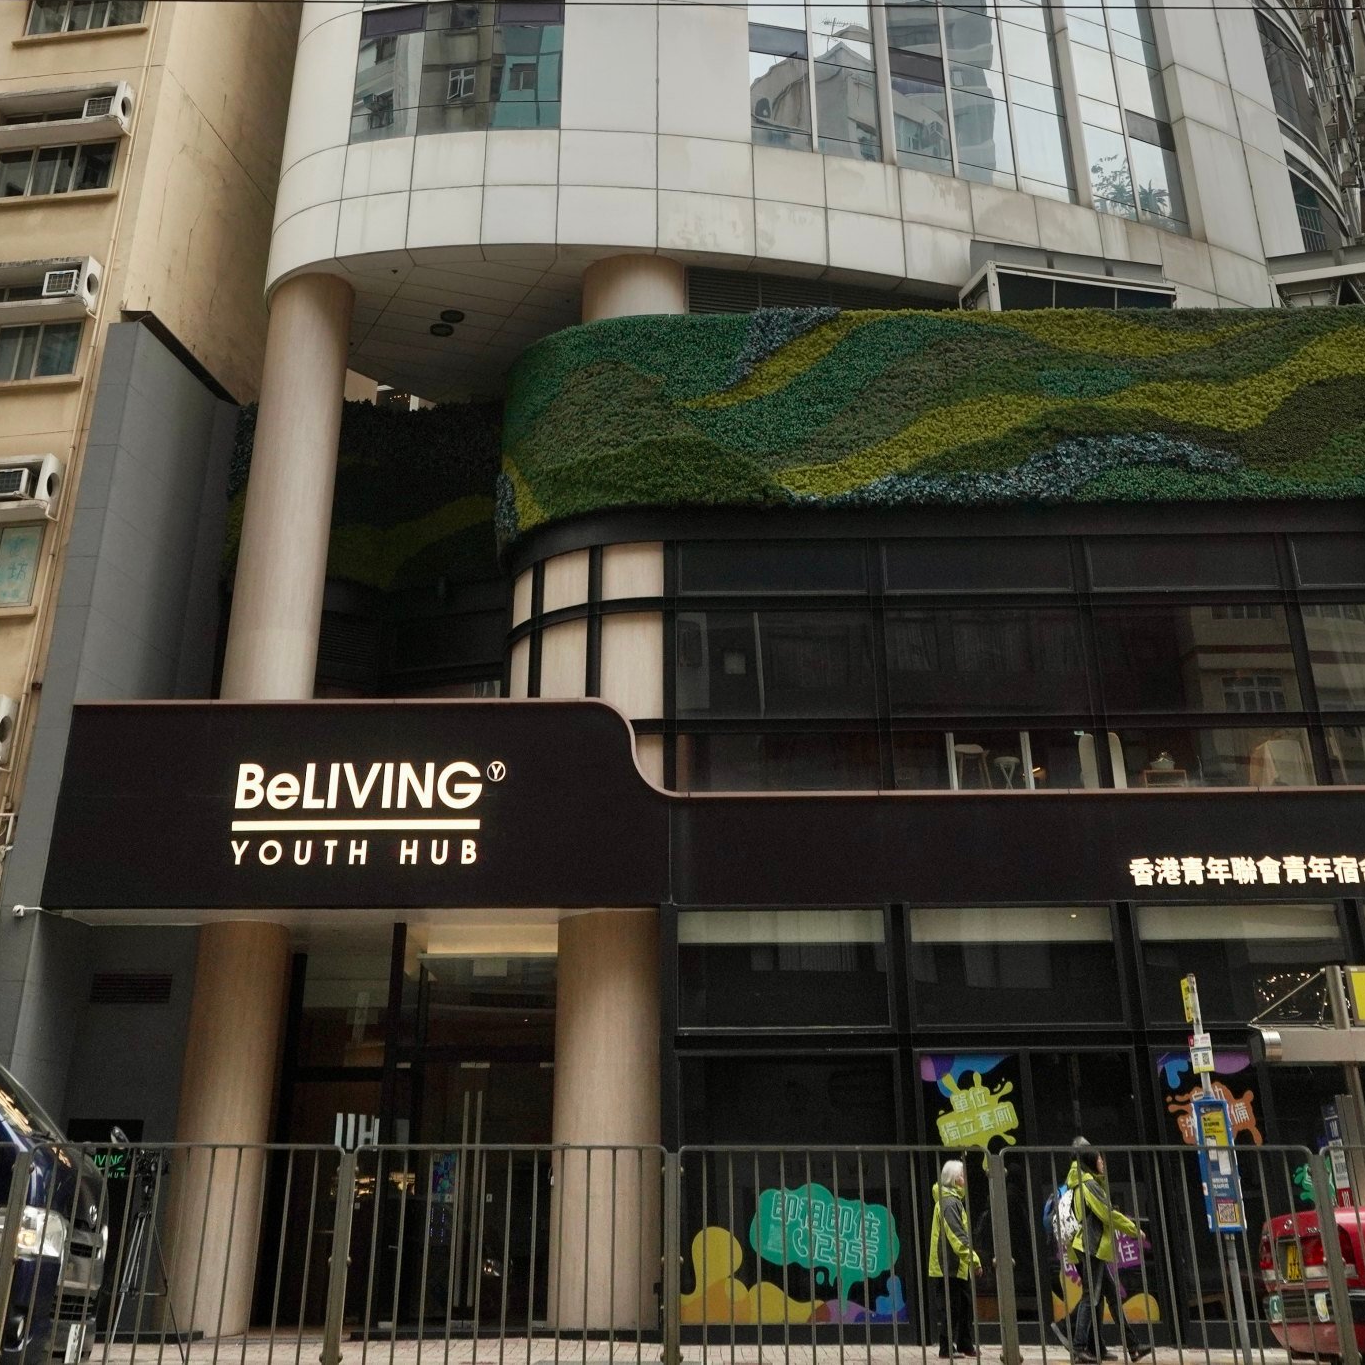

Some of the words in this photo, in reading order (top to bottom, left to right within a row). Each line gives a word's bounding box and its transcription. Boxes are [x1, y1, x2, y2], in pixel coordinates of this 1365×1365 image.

[234, 761, 483, 810] BeLIVING
[231, 839, 368, 866] YOUTH
[399, 839, 478, 866] HUB
